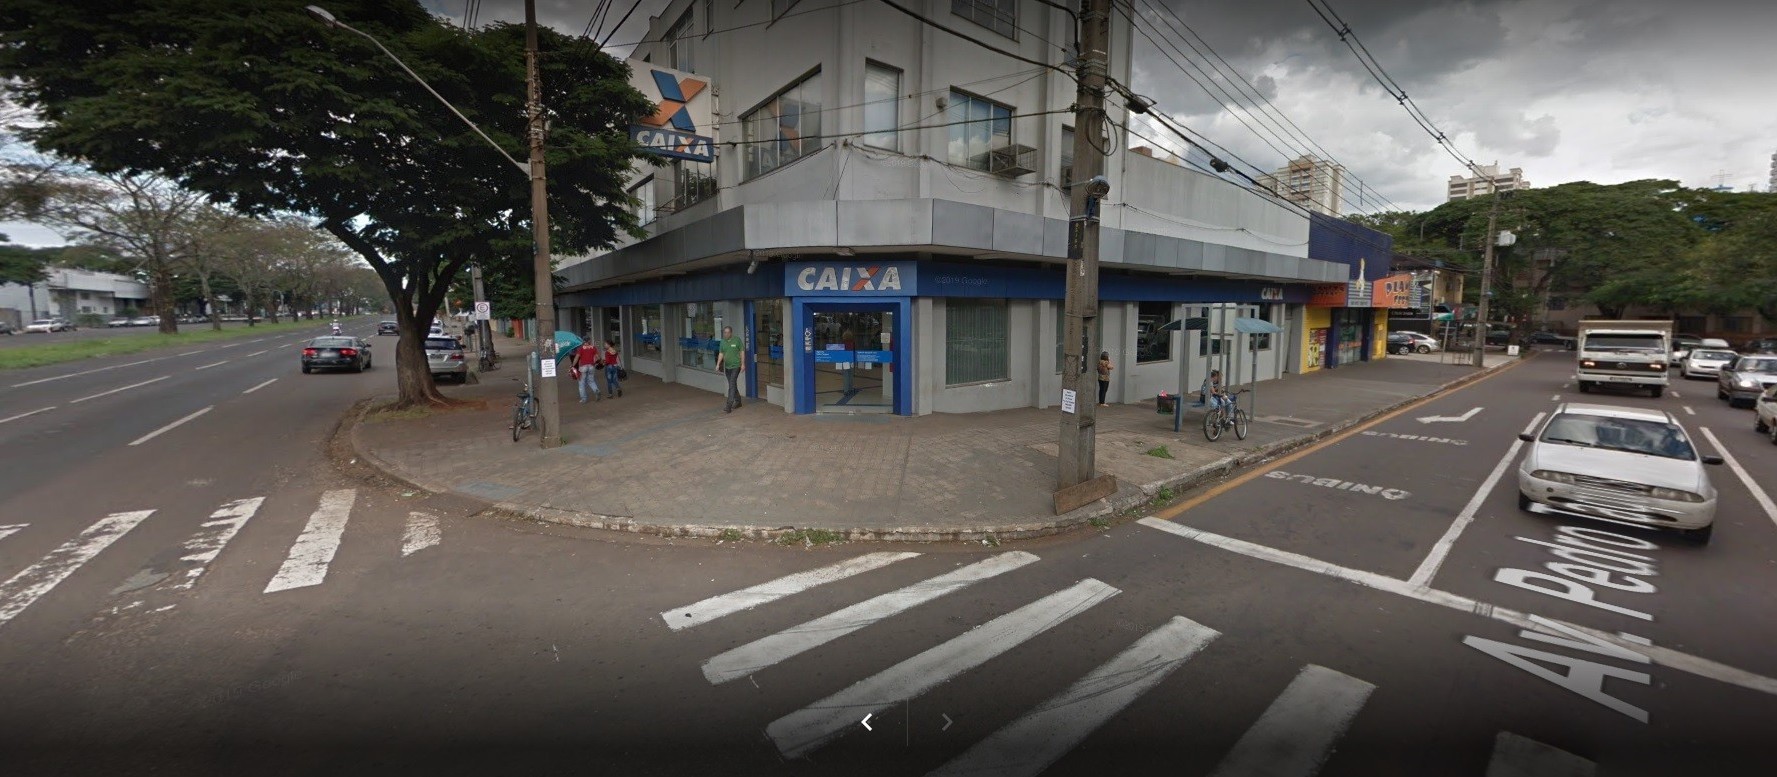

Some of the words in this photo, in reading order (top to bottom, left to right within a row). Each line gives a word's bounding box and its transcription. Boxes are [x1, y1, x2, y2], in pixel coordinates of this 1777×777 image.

[636, 130, 709, 157] CAIXA
[797, 265, 902, 292] CAIXA
[1261, 287, 1284, 300] CAIXA
